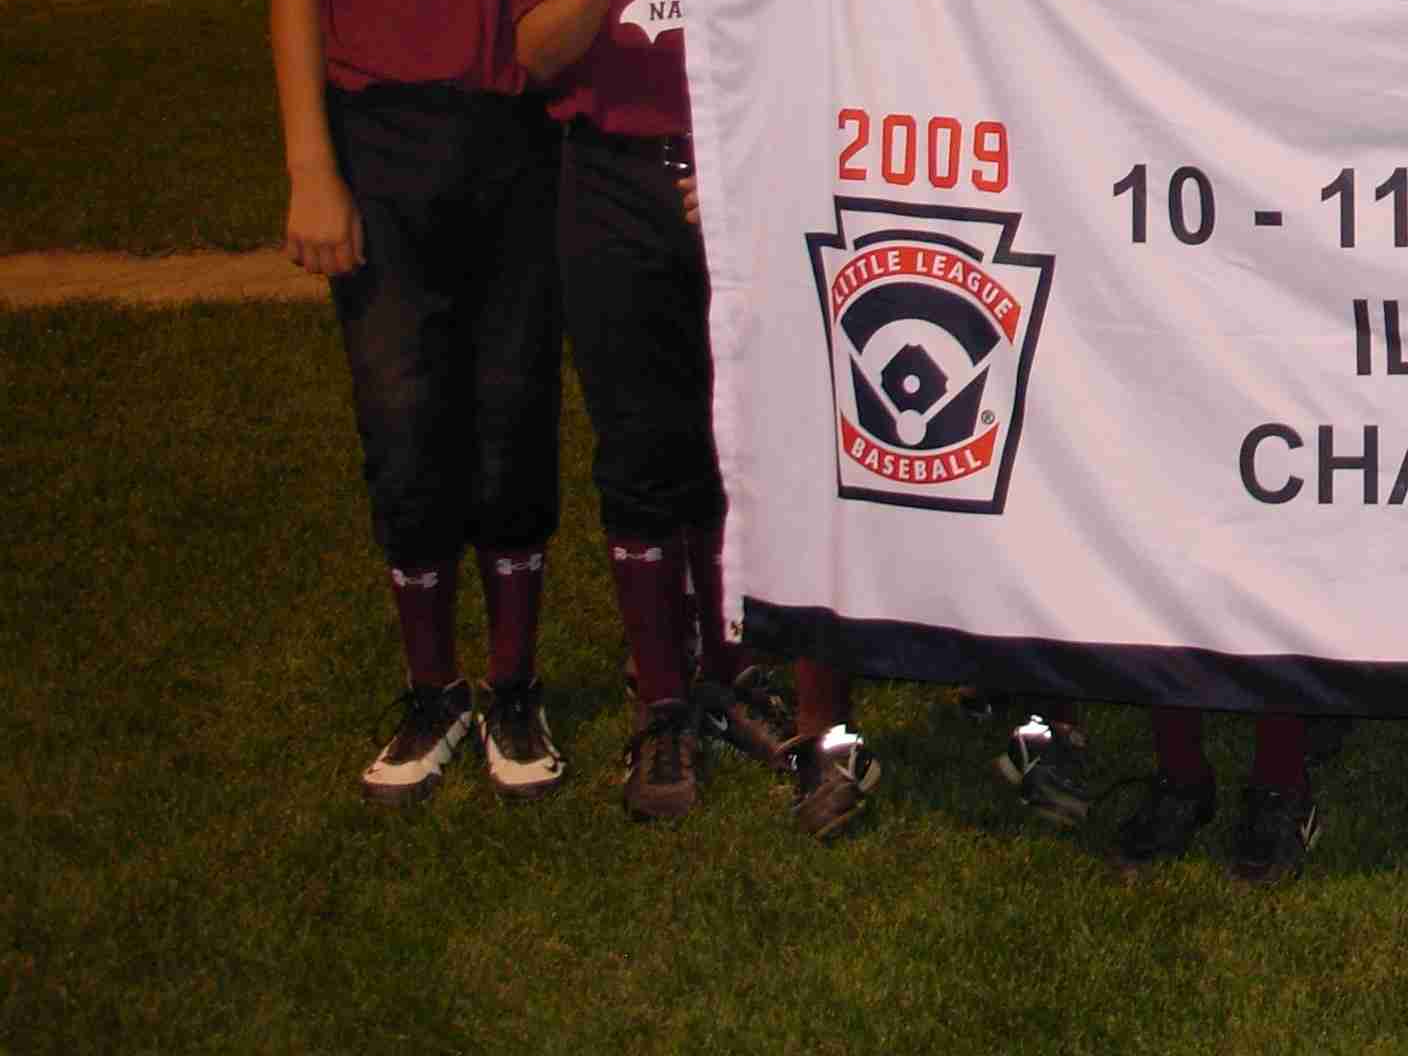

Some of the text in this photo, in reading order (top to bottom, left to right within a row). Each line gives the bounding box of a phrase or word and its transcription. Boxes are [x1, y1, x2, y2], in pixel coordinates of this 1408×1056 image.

[837, 108, 1009, 193] 2009
[1112, 163, 1216, 245] 10
[1320, 167, 1408, 248] 11
[833, 250, 1014, 319] LITTLE LEAGUE
[851, 437, 983, 481] BASEBALL
